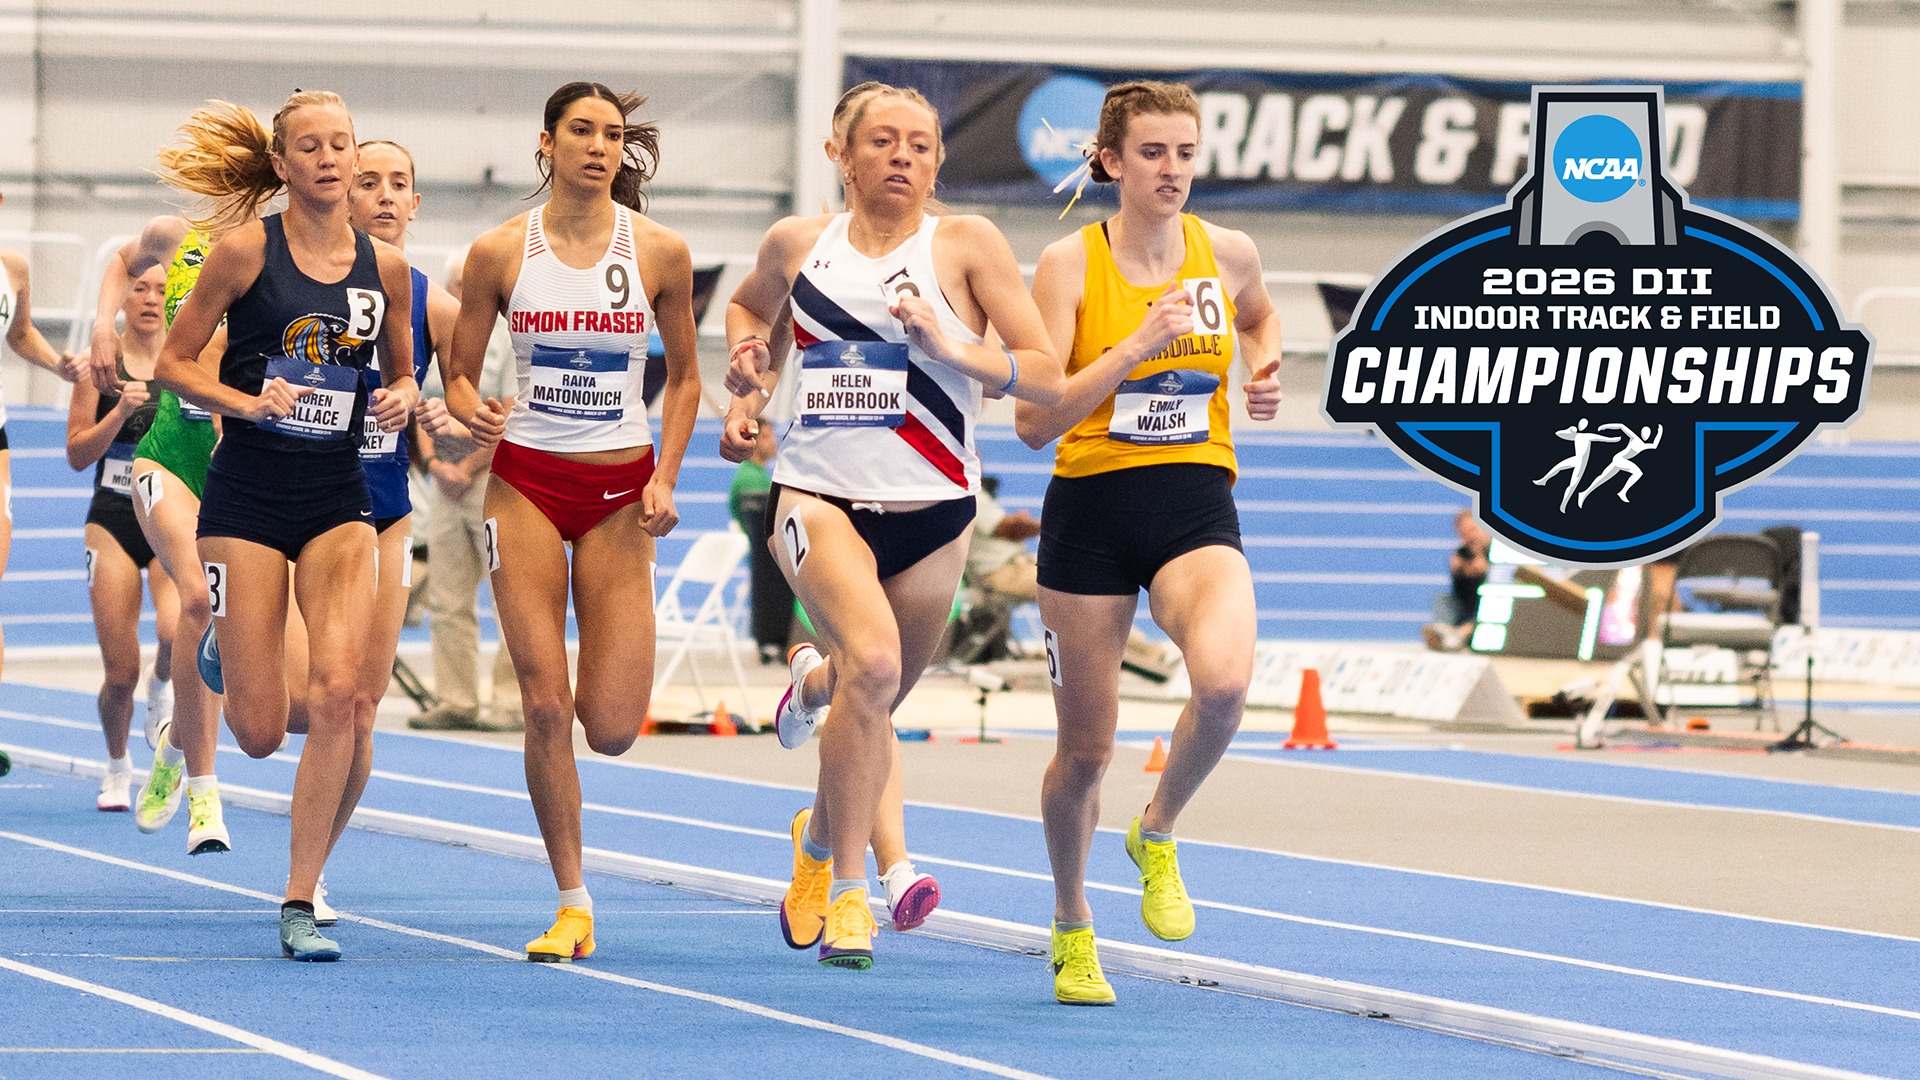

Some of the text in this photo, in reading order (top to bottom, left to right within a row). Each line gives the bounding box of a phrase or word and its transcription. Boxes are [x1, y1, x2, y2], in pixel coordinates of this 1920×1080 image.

[1195, 92, 1408, 184] RACK
[1415, 97, 1479, 185] &
[605, 264, 630, 309] 9
[356, 291, 376, 337] 3
[511, 311, 645, 334] SIMON FRASER
[1196, 281, 1220, 330] 6
[533, 385, 622, 406] MATONOVICH
[562, 374, 596, 388] RAIYA
[832, 374, 871, 388] HELEN
[286, 405, 339, 426] ALLACE
[807, 391, 900, 409] BRAYBROOK
[1149, 399, 1183, 413] EMILY
[1138, 412, 1186, 431] WALSH
[139, 472, 154, 509] 7
[485, 523, 494, 570] 9
[785, 517, 806, 567] 2
[208, 565, 221, 613] 3
[1045, 630, 1057, 679] 6
